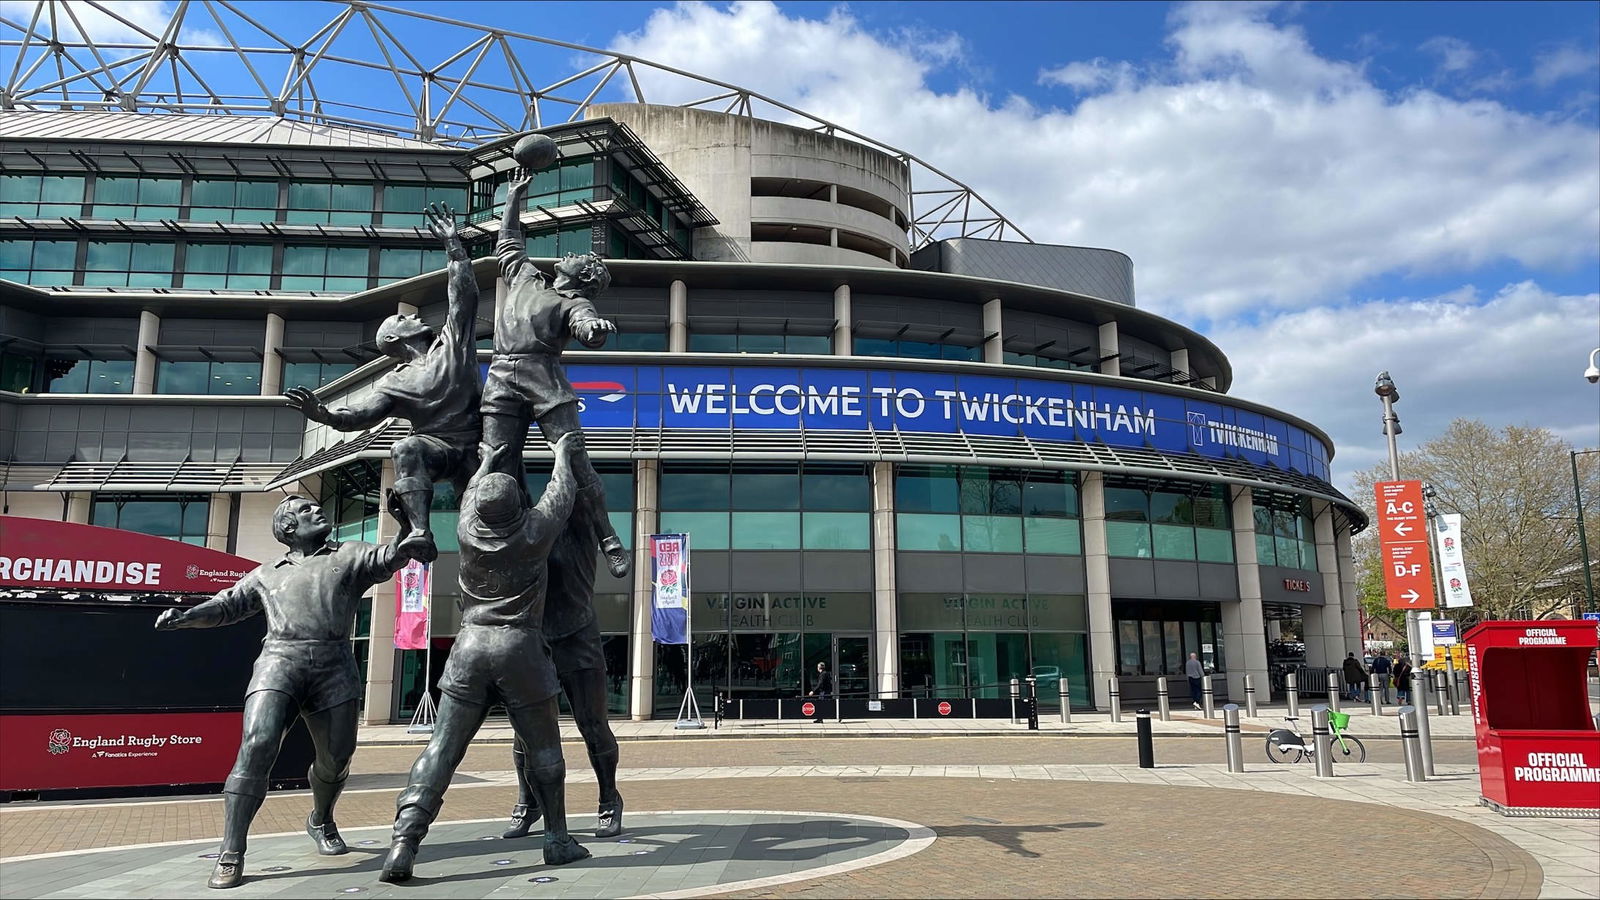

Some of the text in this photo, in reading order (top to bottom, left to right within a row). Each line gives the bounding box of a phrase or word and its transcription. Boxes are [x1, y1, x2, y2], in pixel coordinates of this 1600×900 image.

[667, 384, 1157, 437] WELCOME TO TWICKENHAM
[1208, 421, 1279, 456] TWICKENHAM
[1386, 501, 1415, 515] A-C
[199, 569, 247, 578] England Rugb
[1394, 564, 1421, 577] D-F
[706, 597, 827, 609] VRGIN ACTIVE
[1002, 598, 1049, 609] ACTVE
[1526, 628, 1558, 637] OFFICIAL
[1519, 636, 1567, 645] PROGRAMME
[72, 734, 202, 749] England Rugby Store
[1528, 752, 1587, 768] OFFICIAL
[1514, 767, 1600, 783] PROGRAMME
